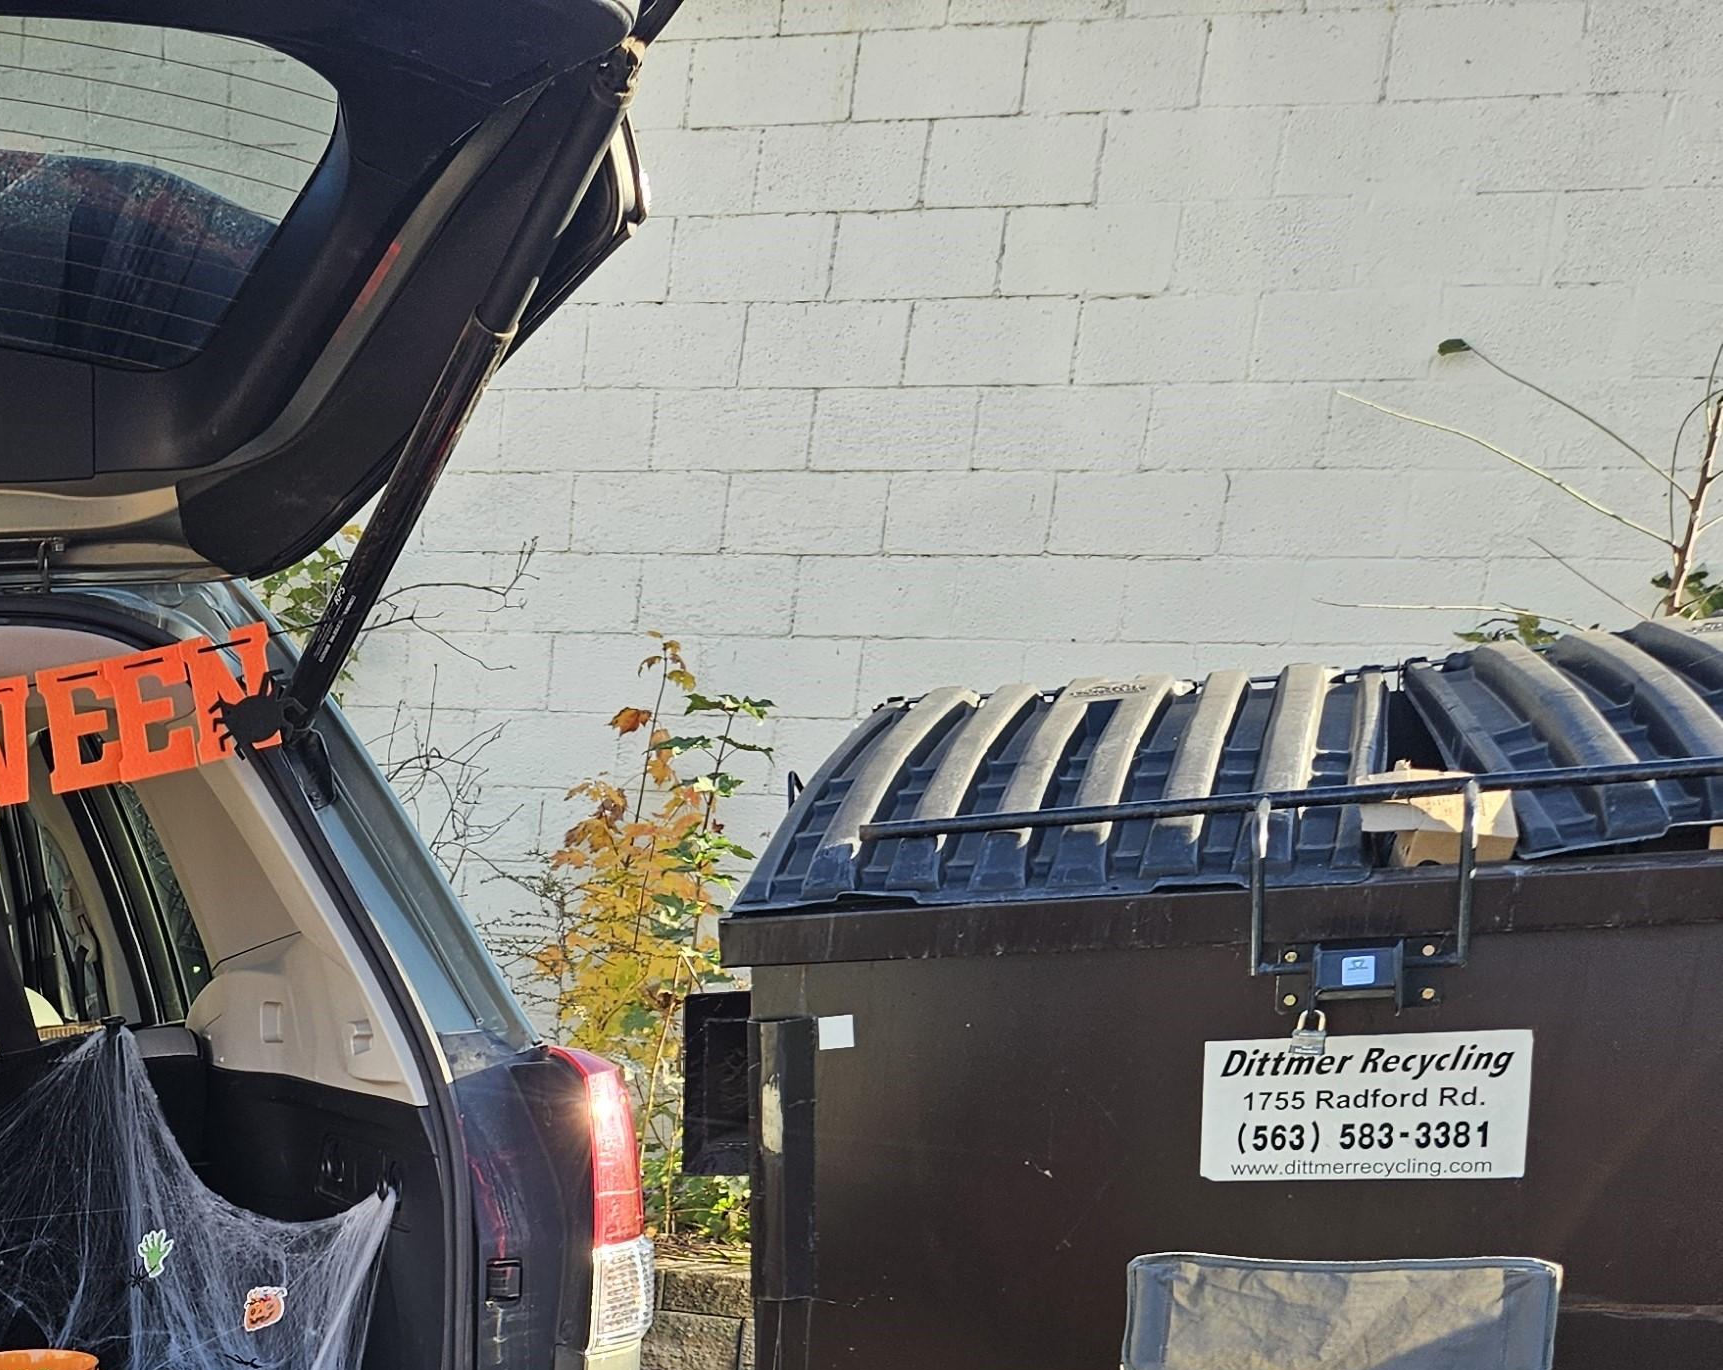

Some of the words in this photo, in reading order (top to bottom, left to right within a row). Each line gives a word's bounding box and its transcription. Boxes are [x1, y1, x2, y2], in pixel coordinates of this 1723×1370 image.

[1220, 1049, 1354, 1078] Dittmer
[1359, 1044, 1515, 1080] Recycling
[1243, 1091, 1306, 1111] 1755
[1316, 1088, 1428, 1111] Radford
[1438, 1086, 1486, 1107] Rd.
[1237, 1121, 1321, 1154] (563)
[1339, 1120, 1490, 1150] 583-3381
[1230, 1158, 1492, 1178] www.dittmerrecycling.com
